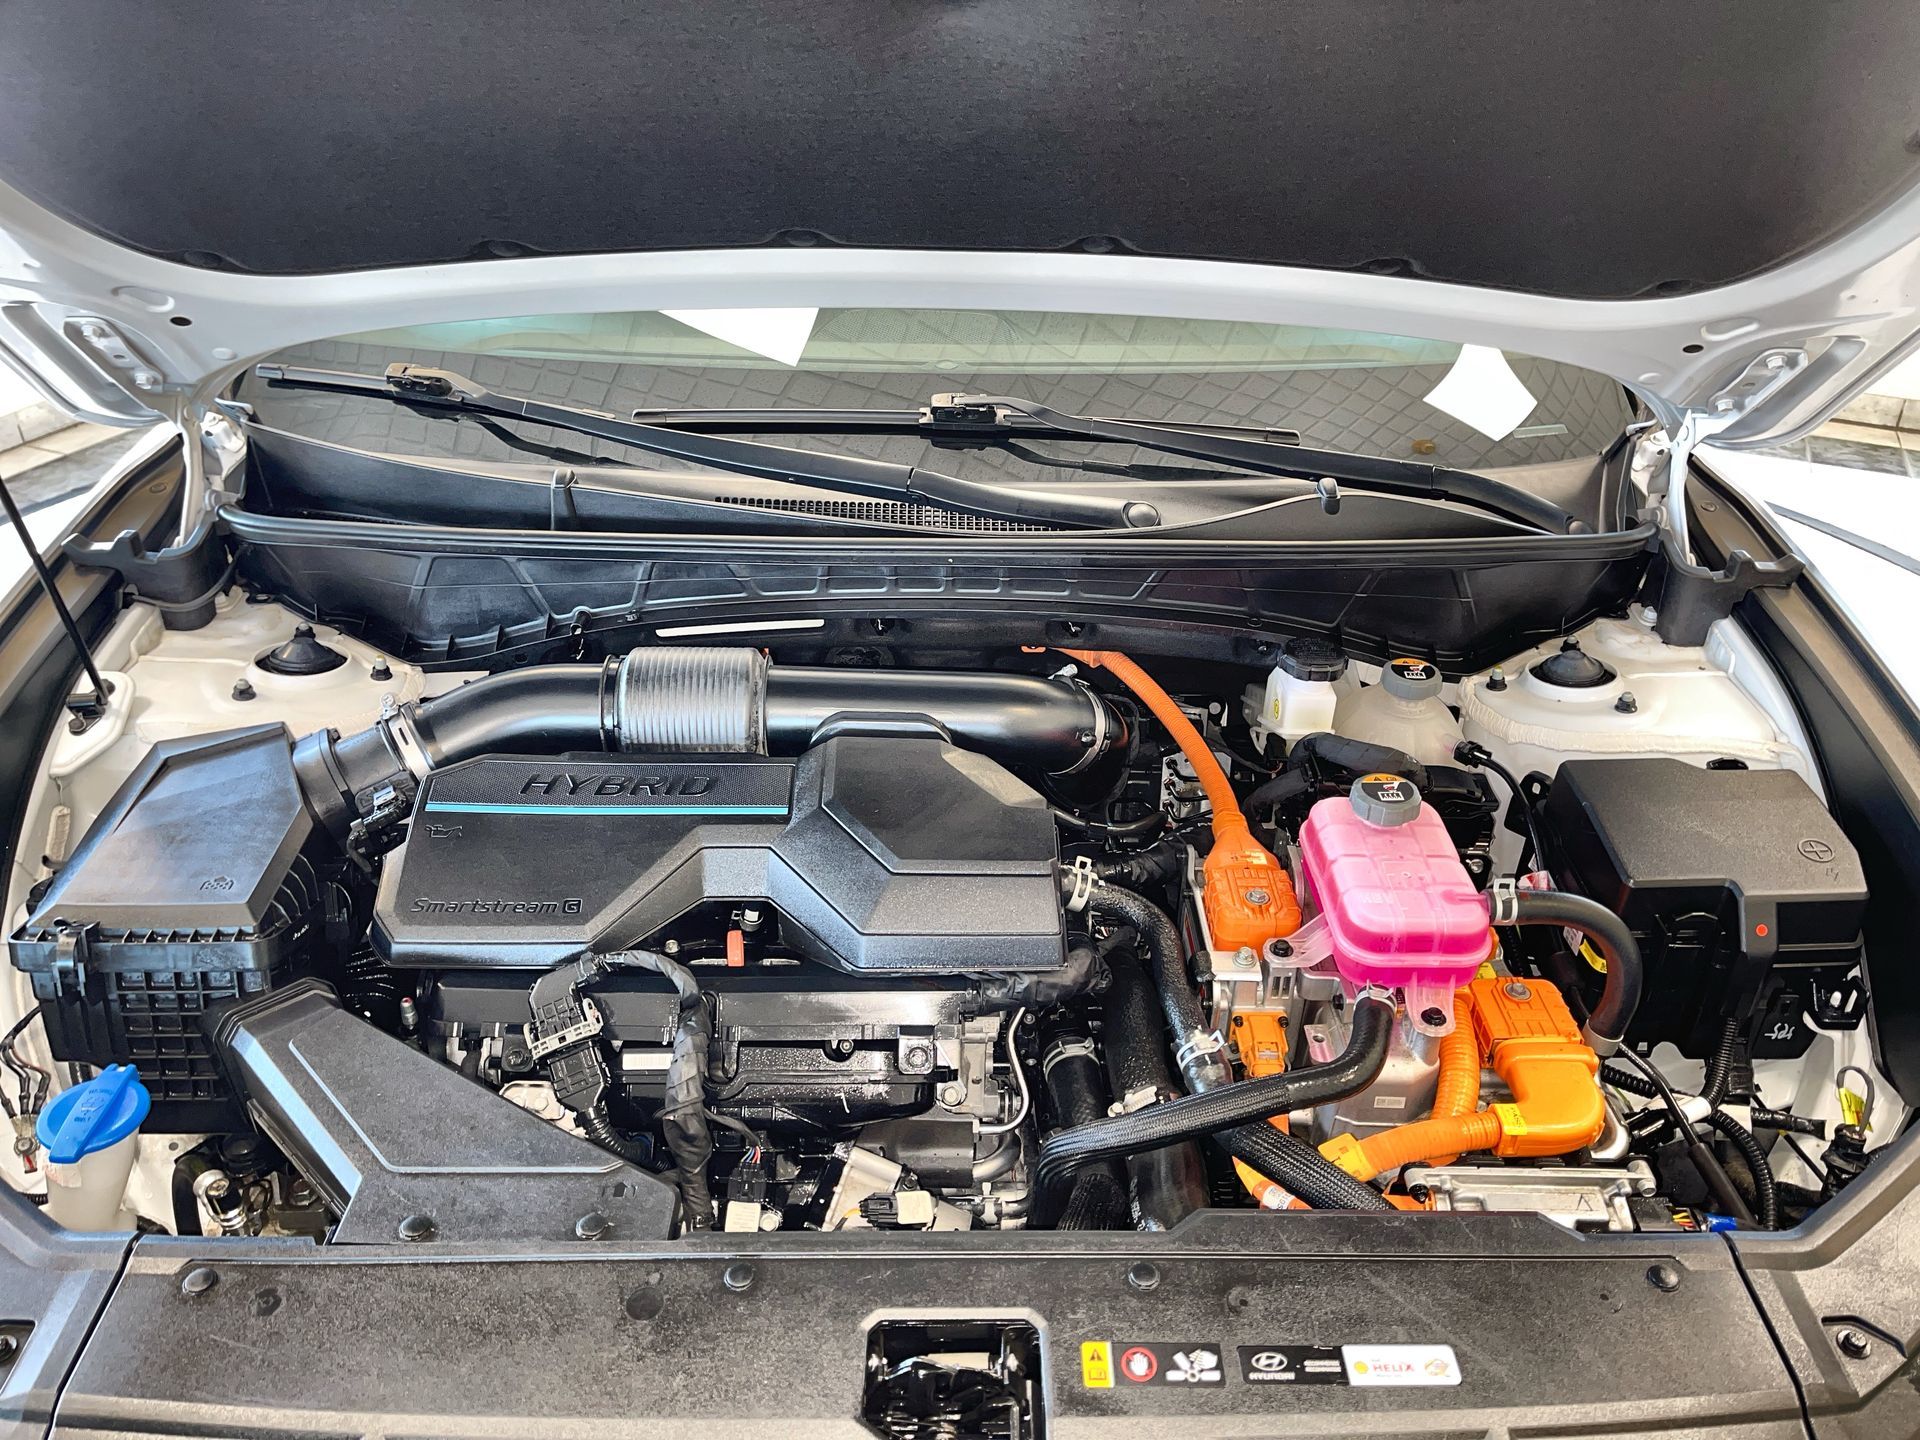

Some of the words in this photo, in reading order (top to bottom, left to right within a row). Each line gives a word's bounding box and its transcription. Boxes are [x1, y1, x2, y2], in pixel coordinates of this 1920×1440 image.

[518, 773, 719, 796] HYBRID
[411, 897, 559, 914] Smartstream
[1373, 1364, 1415, 1372] HELIX
[1248, 1372, 1296, 1380] HYUNDAI
